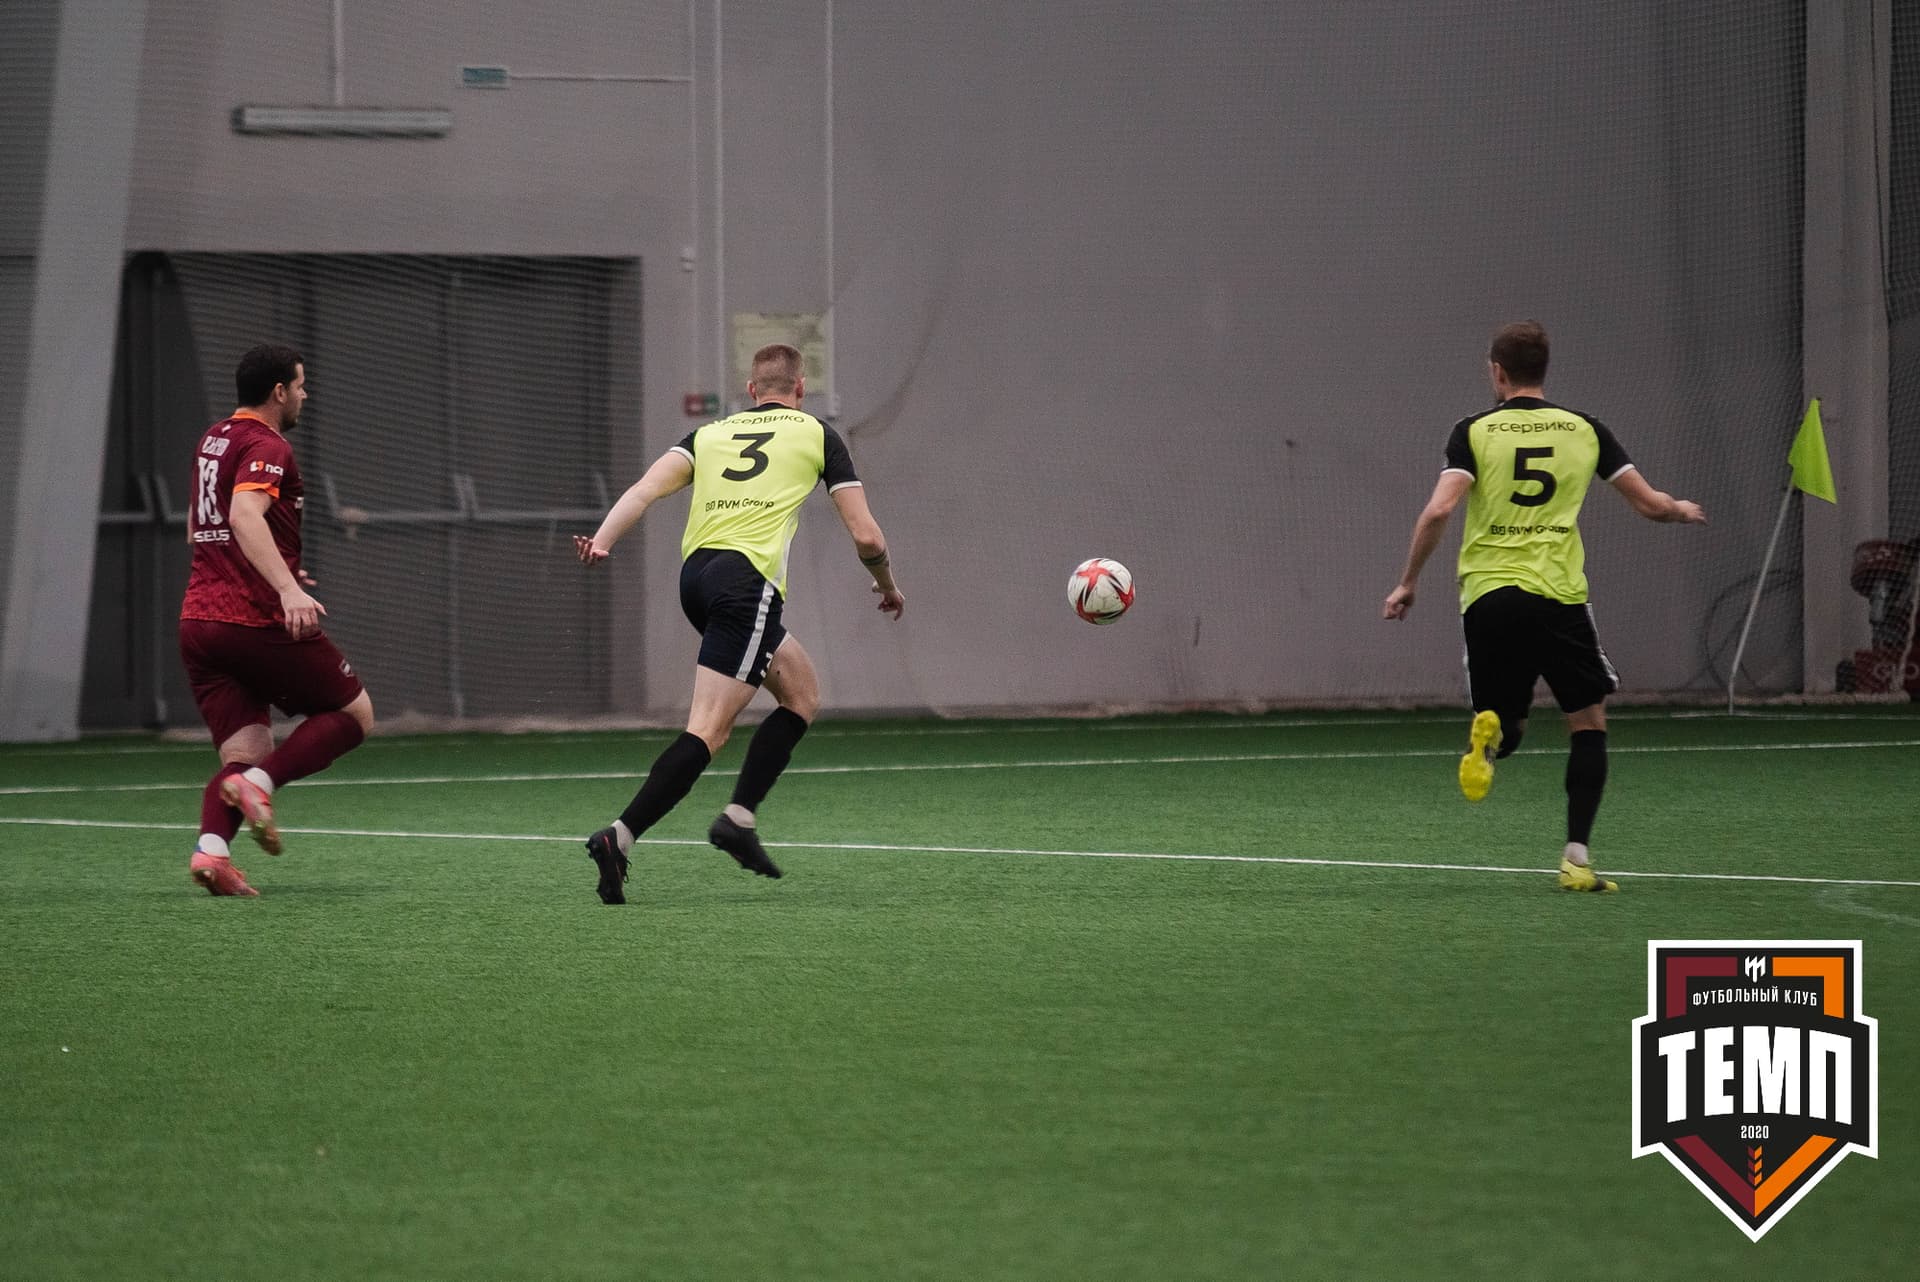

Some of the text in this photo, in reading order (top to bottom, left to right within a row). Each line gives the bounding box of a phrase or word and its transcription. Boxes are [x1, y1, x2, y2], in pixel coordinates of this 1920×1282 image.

[1499, 421, 1577, 434] сервико
[721, 431, 776, 482] 3
[1509, 446, 1557, 507] 5
[717, 497, 775, 510] RVM Group
[1508, 525, 1570, 536] RVM Group
